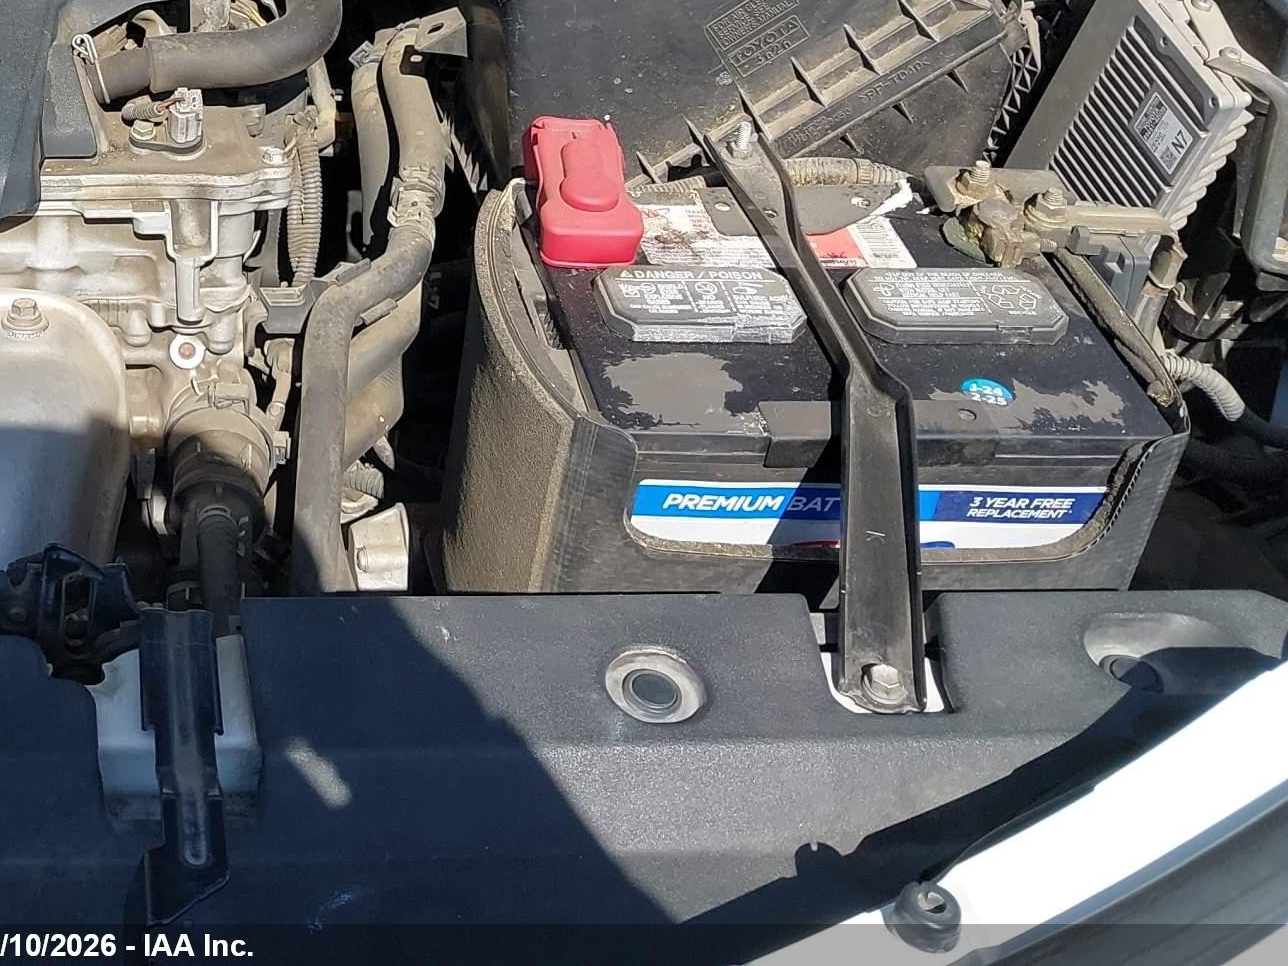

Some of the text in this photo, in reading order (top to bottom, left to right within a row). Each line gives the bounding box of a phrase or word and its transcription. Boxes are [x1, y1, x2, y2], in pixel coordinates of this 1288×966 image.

[735, 18, 801, 62] TOYOTA
[634, 271, 694, 280] DANGER
[708, 271, 763, 280] POISON
[662, 493, 841, 512] PREMIUM BAT
[969, 496, 1076, 510] 3 YEAR FREE
